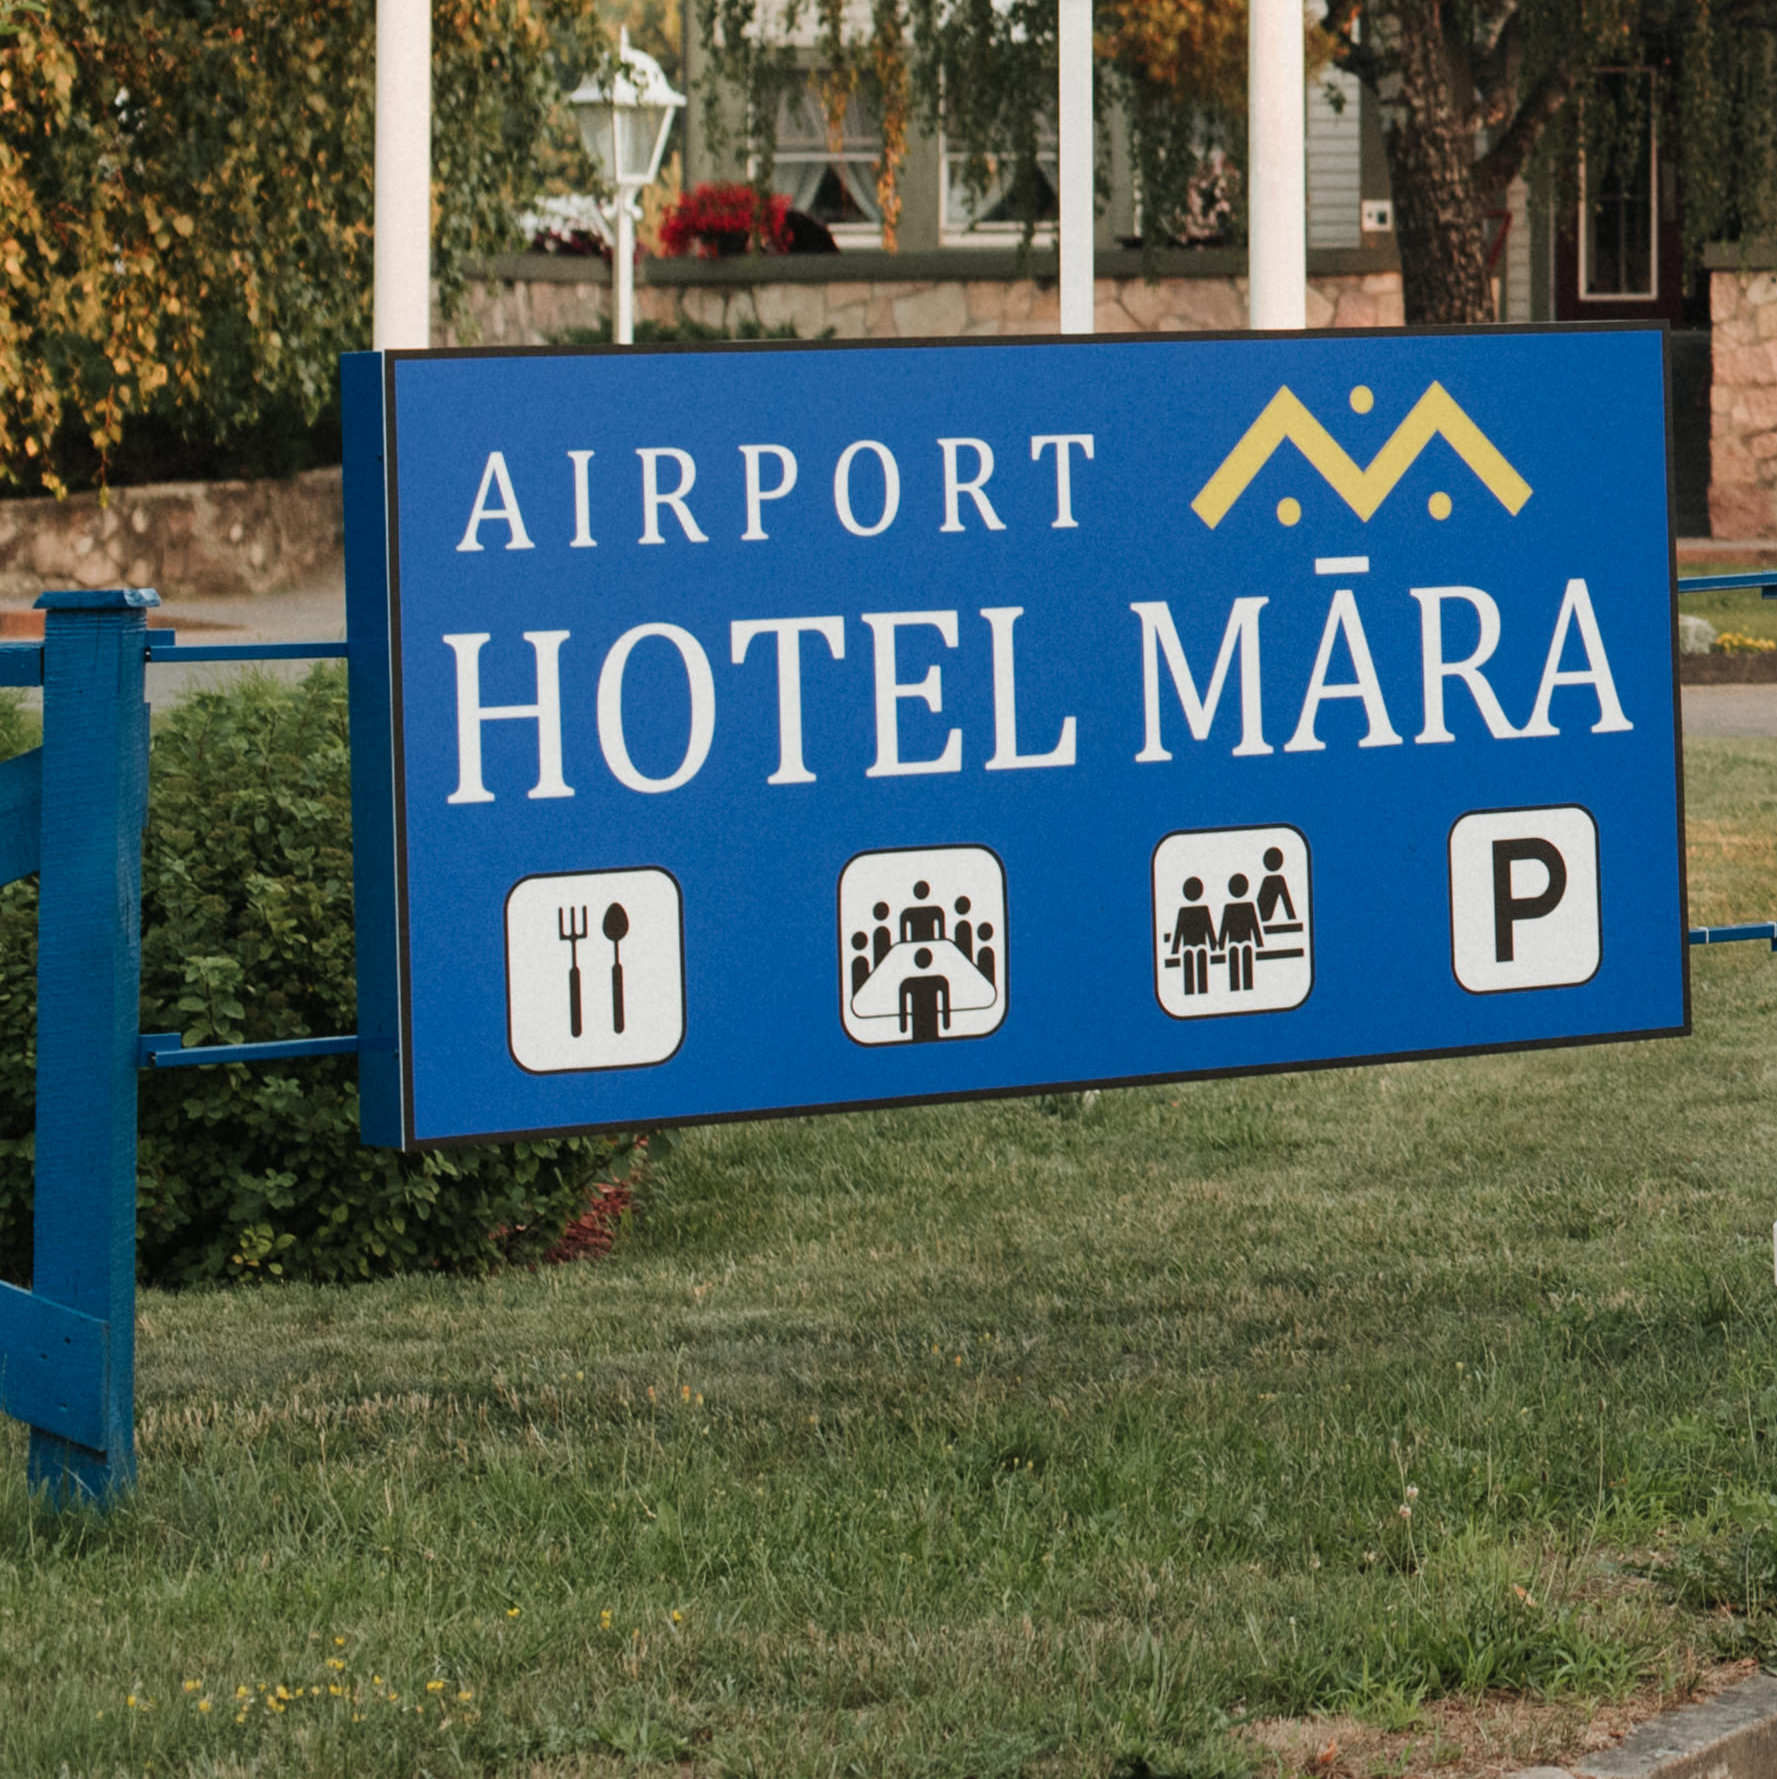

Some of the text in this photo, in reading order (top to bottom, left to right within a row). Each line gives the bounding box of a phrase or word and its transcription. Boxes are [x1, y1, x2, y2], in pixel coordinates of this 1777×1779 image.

[455, 433, 1095, 552] AIRPORT
[442, 556, 1634, 804] HOTEL MĀRA
[1491, 836, 1567, 963] P
